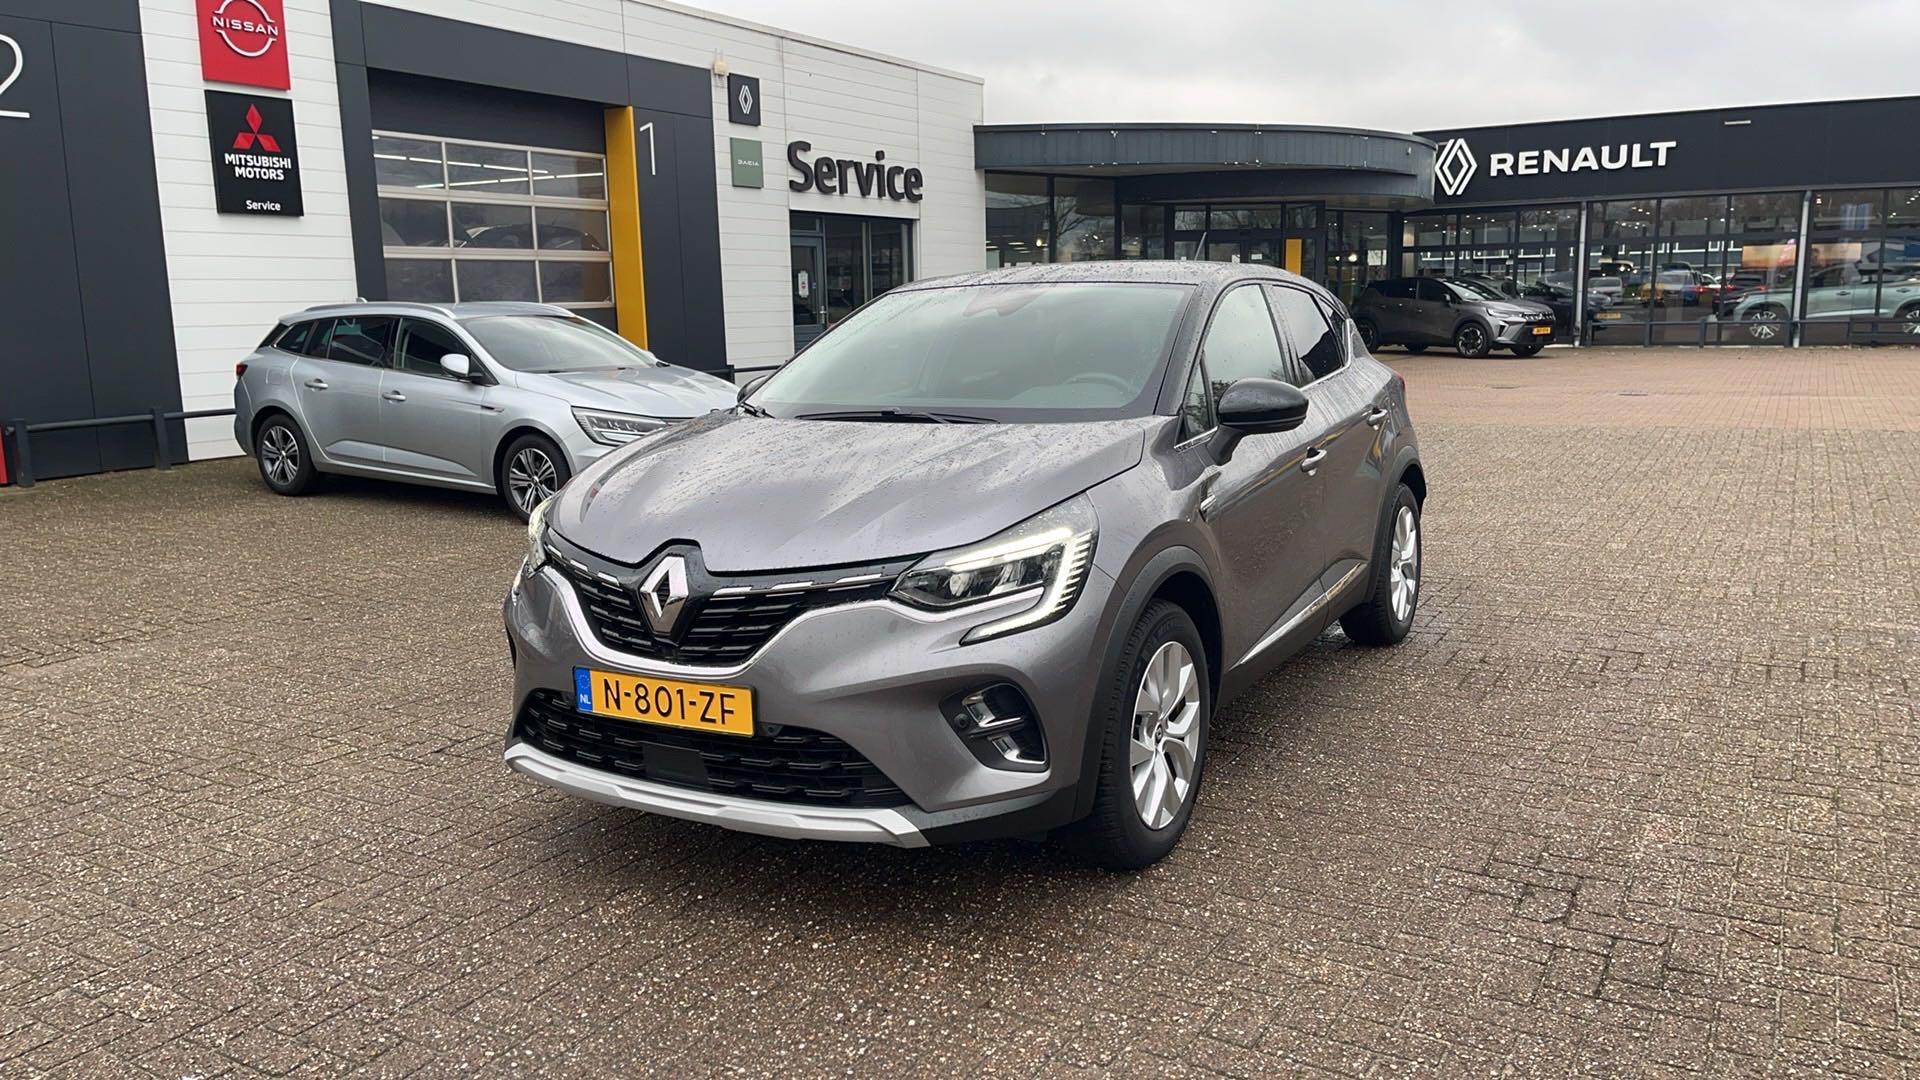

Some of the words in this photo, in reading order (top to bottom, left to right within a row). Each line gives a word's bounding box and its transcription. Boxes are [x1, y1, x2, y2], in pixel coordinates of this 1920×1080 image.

[213, 16, 278, 36] NISSAN
[639, 122, 656, 176] 1
[1490, 141, 1676, 176] RENAULT
[225, 153, 291, 168] MITSUBISHI
[235, 167, 284, 180] MOTORS
[787, 140, 923, 203] Service
[246, 200, 281, 211] Service
[580, 694, 591, 704] NL
[604, 678, 735, 724] N-801-ZF
